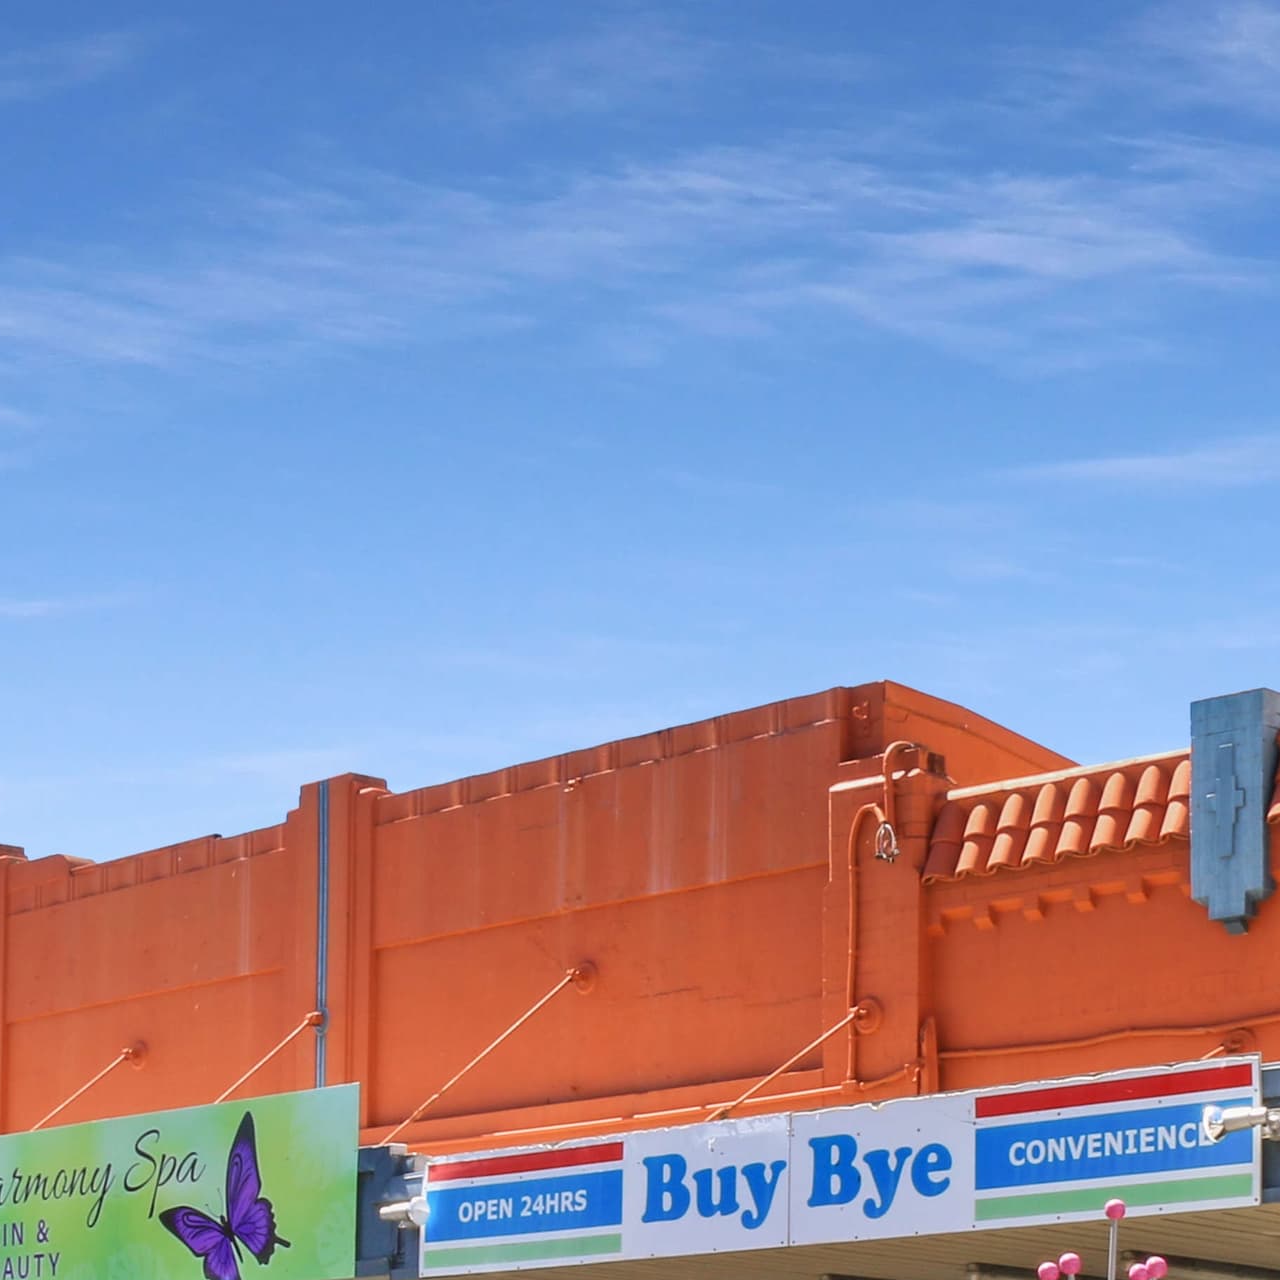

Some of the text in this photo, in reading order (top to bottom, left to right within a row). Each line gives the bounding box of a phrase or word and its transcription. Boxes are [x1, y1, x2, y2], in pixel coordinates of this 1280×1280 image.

[123, 1129, 207, 1219] Spa
[640, 1133, 953, 1231] Buy Bye
[36, 1220, 51, 1243] &
[458, 1189, 588, 1223] OPEN 24HRS
